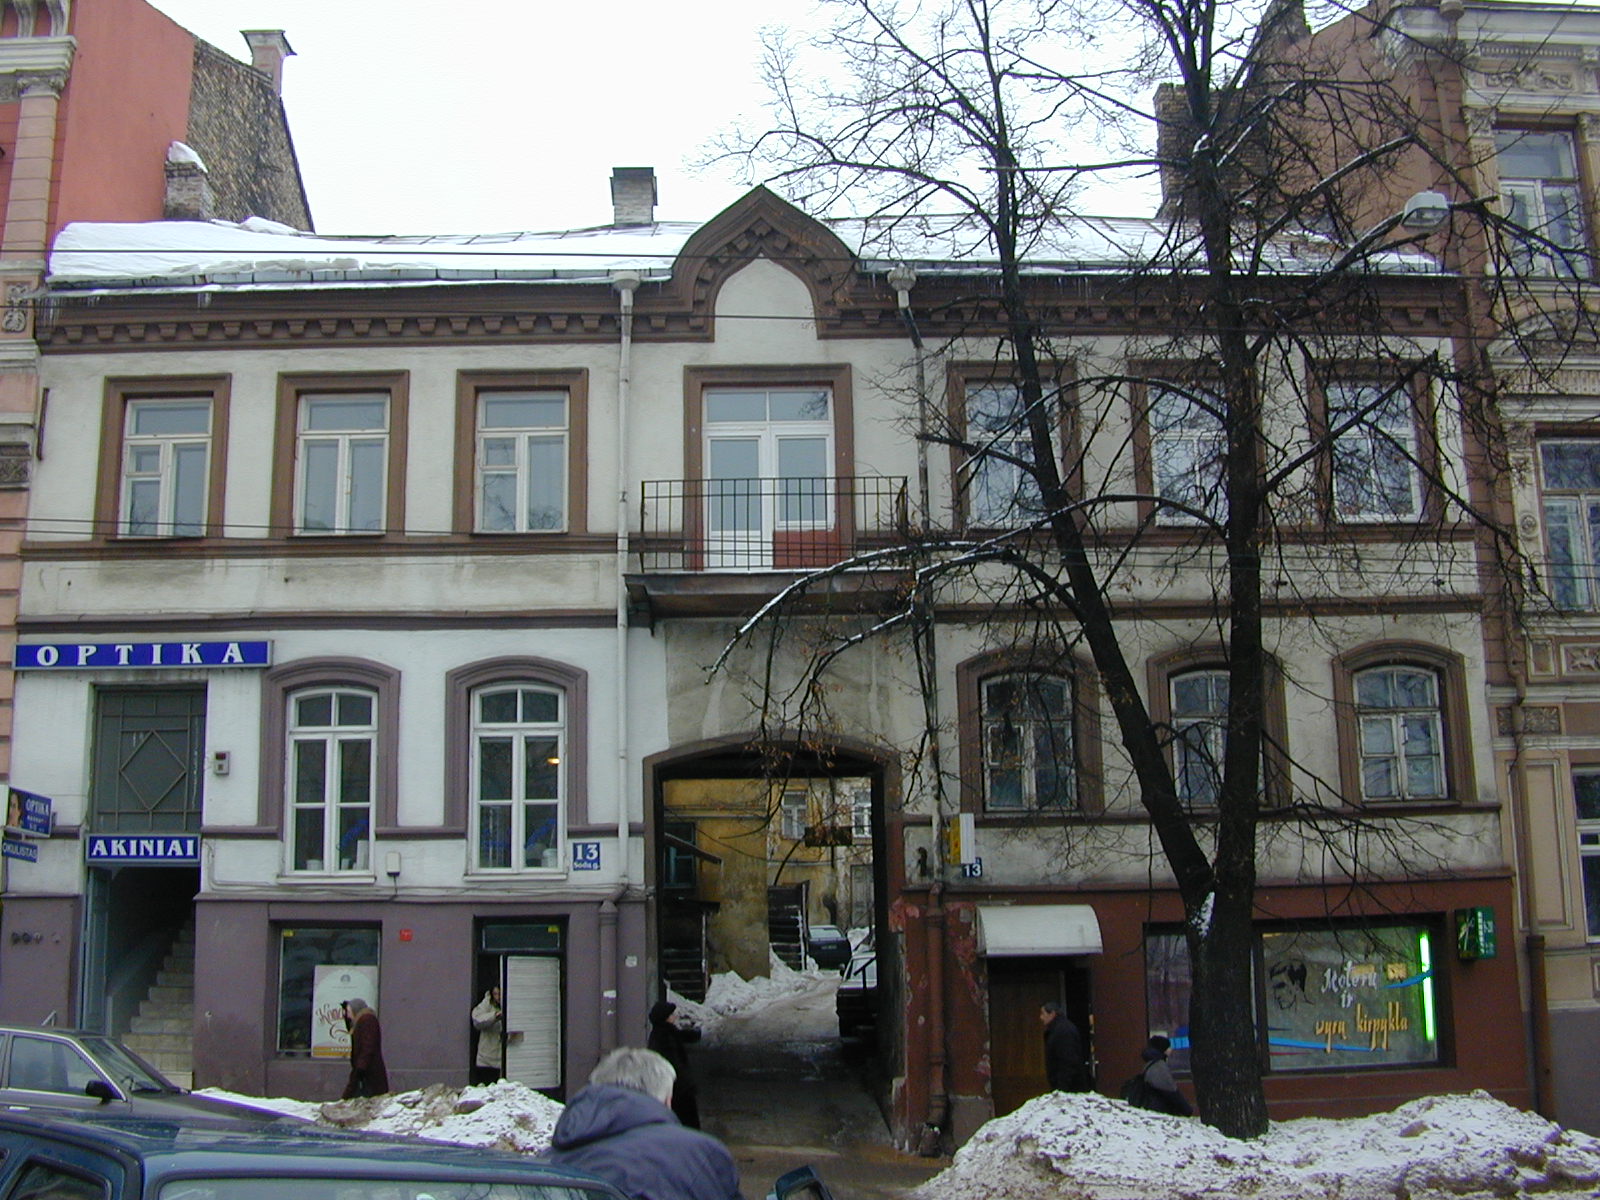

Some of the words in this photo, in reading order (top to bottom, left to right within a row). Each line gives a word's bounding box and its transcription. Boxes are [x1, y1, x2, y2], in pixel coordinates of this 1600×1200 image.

[37, 642, 244, 666] OPTIKA
[25, 799, 49, 816] OPTIKA
[91, 839, 194, 856] AKINIAI
[576, 844, 598, 860] 13
[964, 863, 981, 877] 13
[1341, 990, 1353, 1008] ir
[1357, 1001, 1408, 1052] kirpykla
